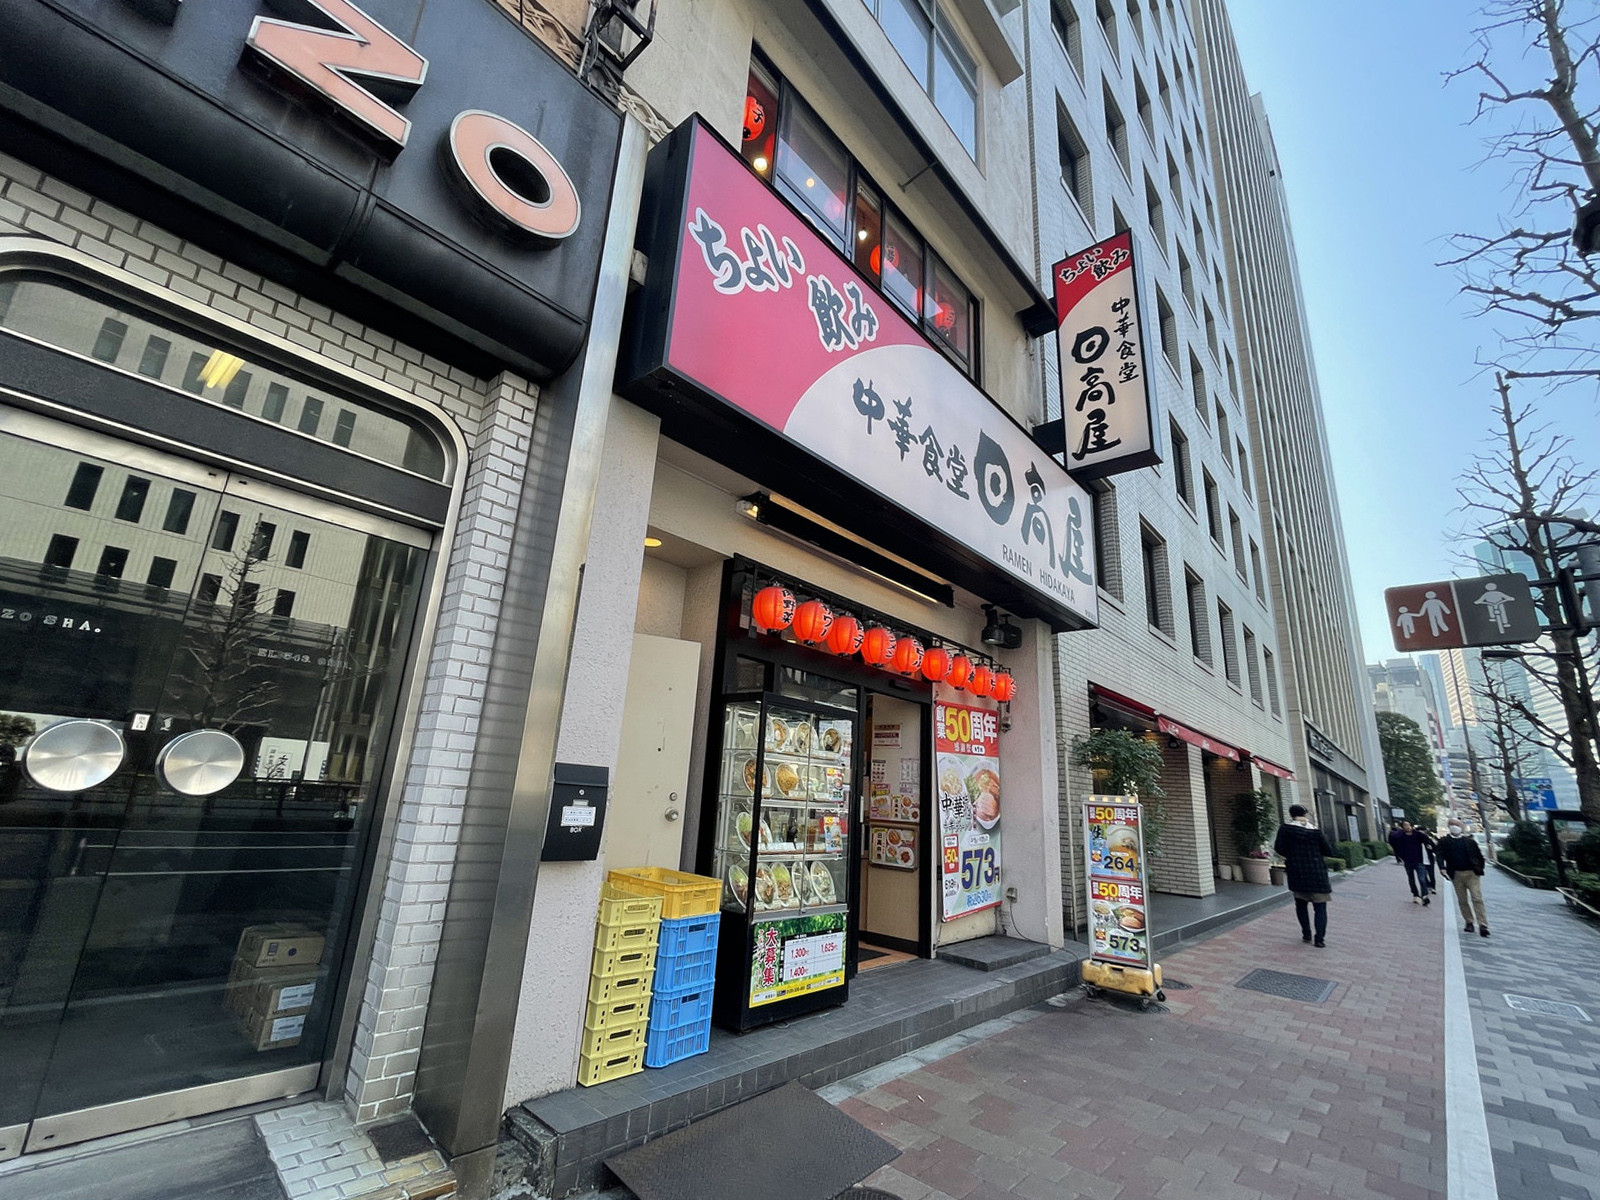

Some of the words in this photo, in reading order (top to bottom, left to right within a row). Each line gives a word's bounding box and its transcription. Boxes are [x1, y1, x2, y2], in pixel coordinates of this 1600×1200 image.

[178, 0, 582, 240] ZO
[1111, 296, 1139, 384] 中華食堂
[1071, 325, 1122, 461] 日高屋
[852, 378, 970, 500] 中華食堂
[973, 428, 1093, 586] 日高屋
[1002, 544, 1032, 577] RAMEN
[1039, 568, 1076, 604] HIDAKAYA
[945, 706, 998, 744] 50周年
[1096, 807, 1137, 821] 50周年
[1099, 882, 1143, 900] 50周年
[762, 926, 778, 988] 大募集
